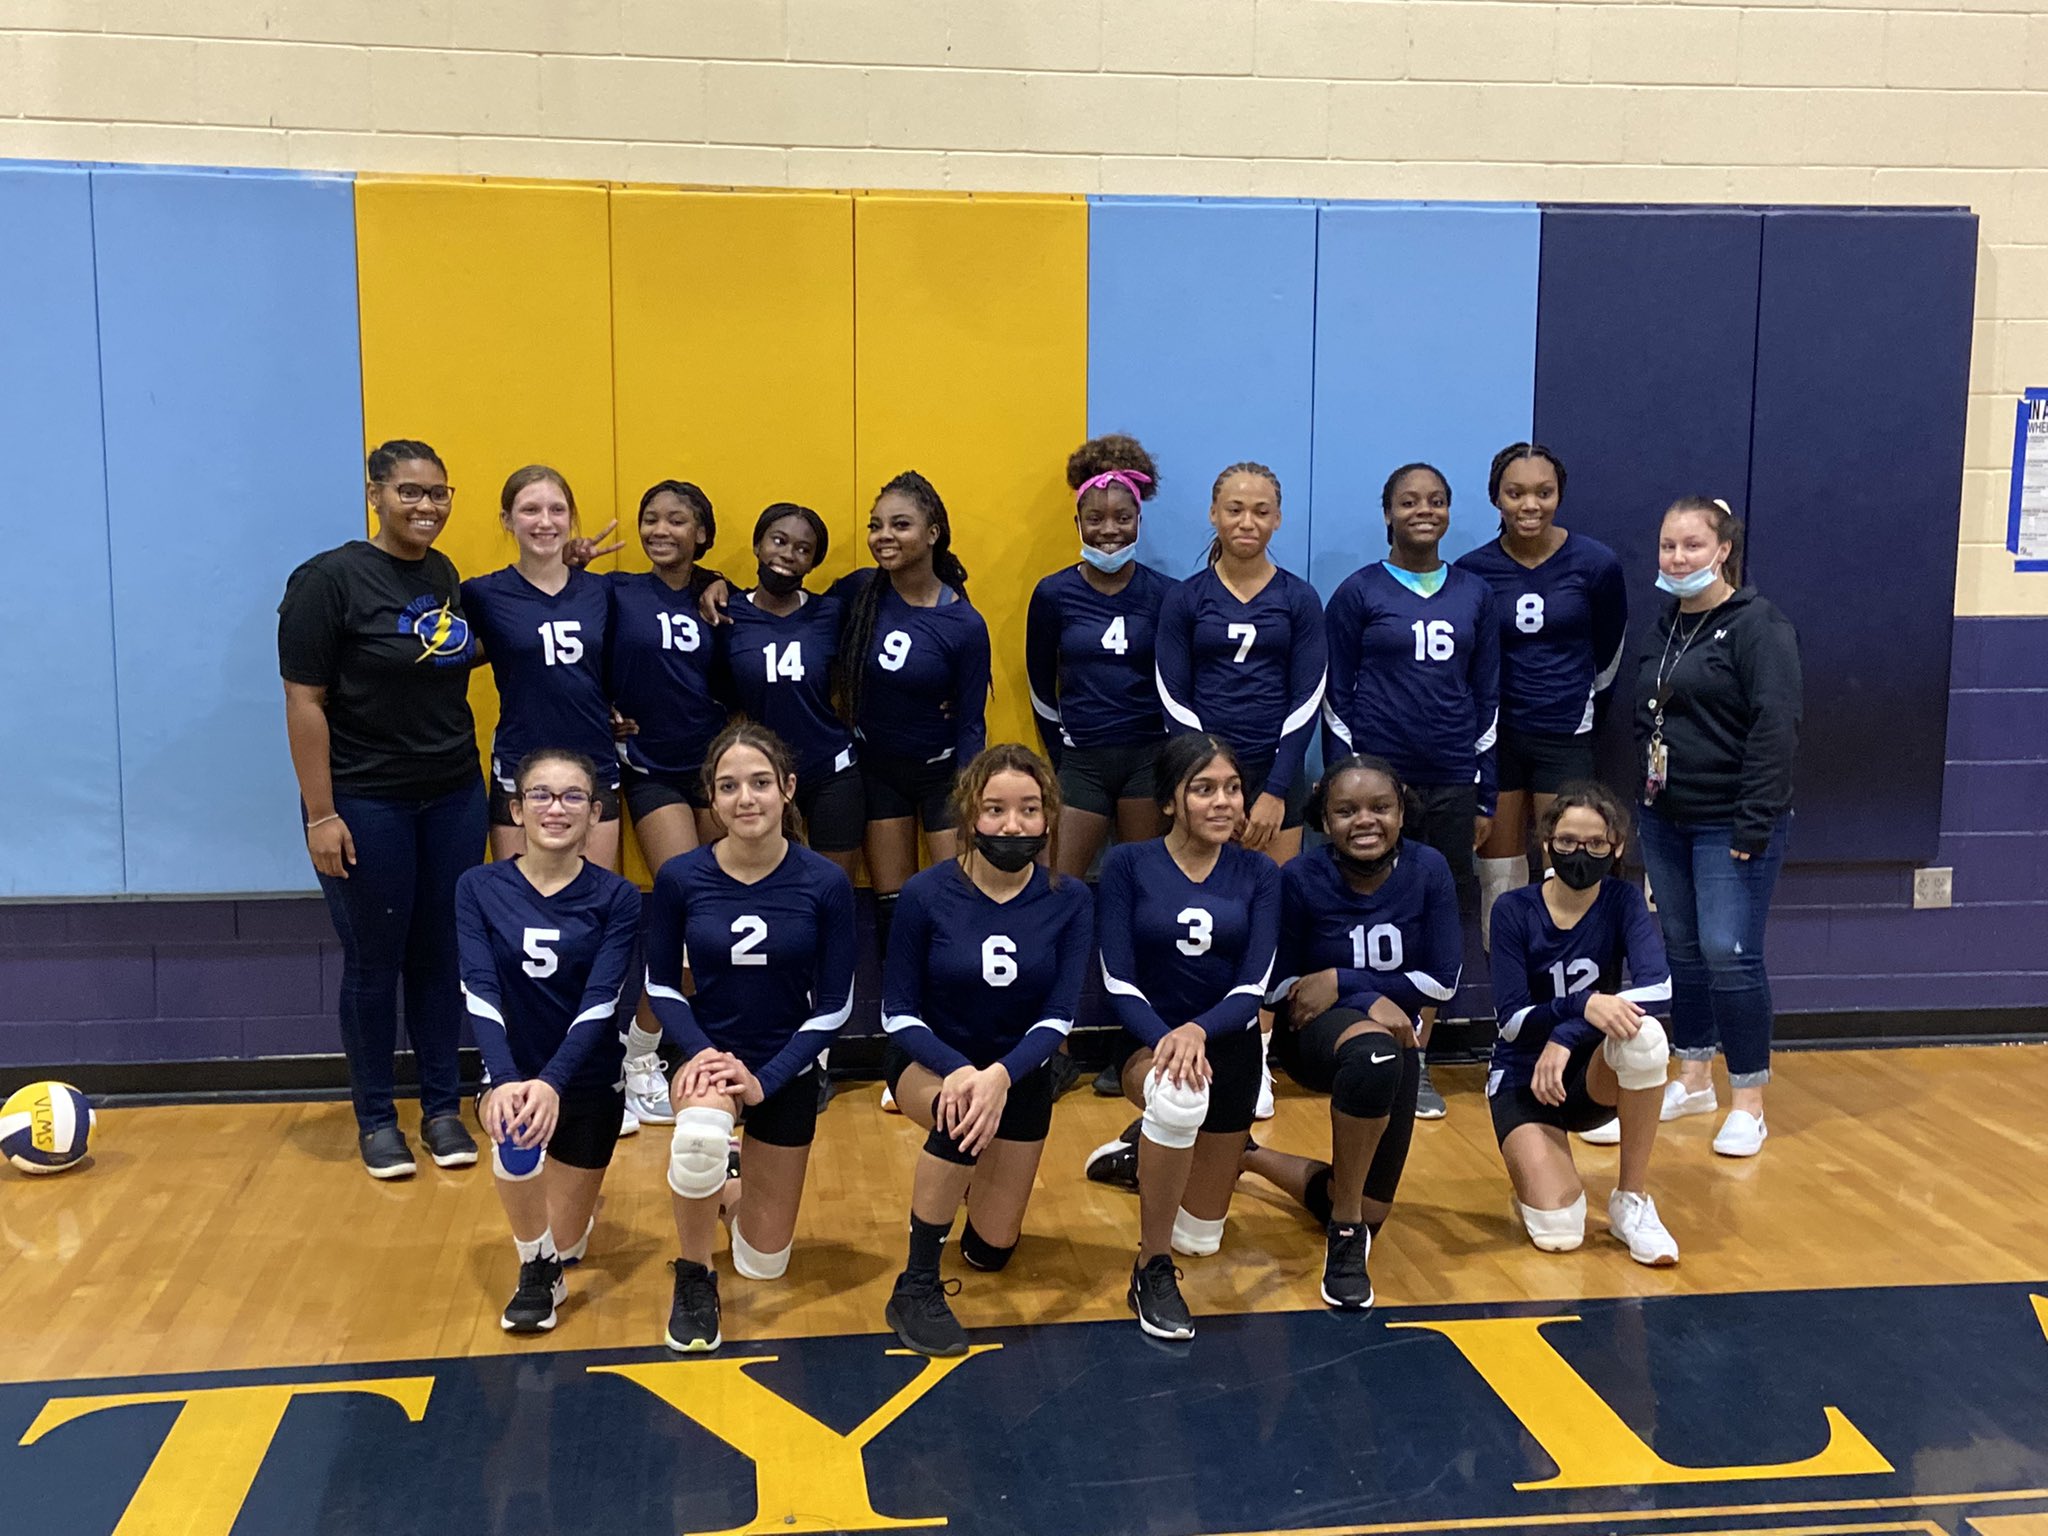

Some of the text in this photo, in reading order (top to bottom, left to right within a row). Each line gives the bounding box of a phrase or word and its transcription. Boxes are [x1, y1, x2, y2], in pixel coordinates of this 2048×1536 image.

[2028, 421, 2048, 433] WHE
[2029, 400, 2041, 420] IN
[656, 611, 701, 653] 13
[1515, 592, 1545, 634] 8
[537, 620, 584, 666] 15
[877, 629, 913, 672] 9
[1100, 615, 1129, 655] 4
[1227, 622, 1258, 663] 7
[1410, 619, 1455, 661] 16
[762, 640, 806, 683] 14
[521, 926, 561, 979] 5
[730, 914, 768, 966] 2
[1175, 907, 1214, 957] 3
[1348, 922, 1404, 972] 10
[981, 934, 1018, 987] 6
[1549, 957, 1600, 998] 12
[34, 1096, 53, 1146] VLMS
